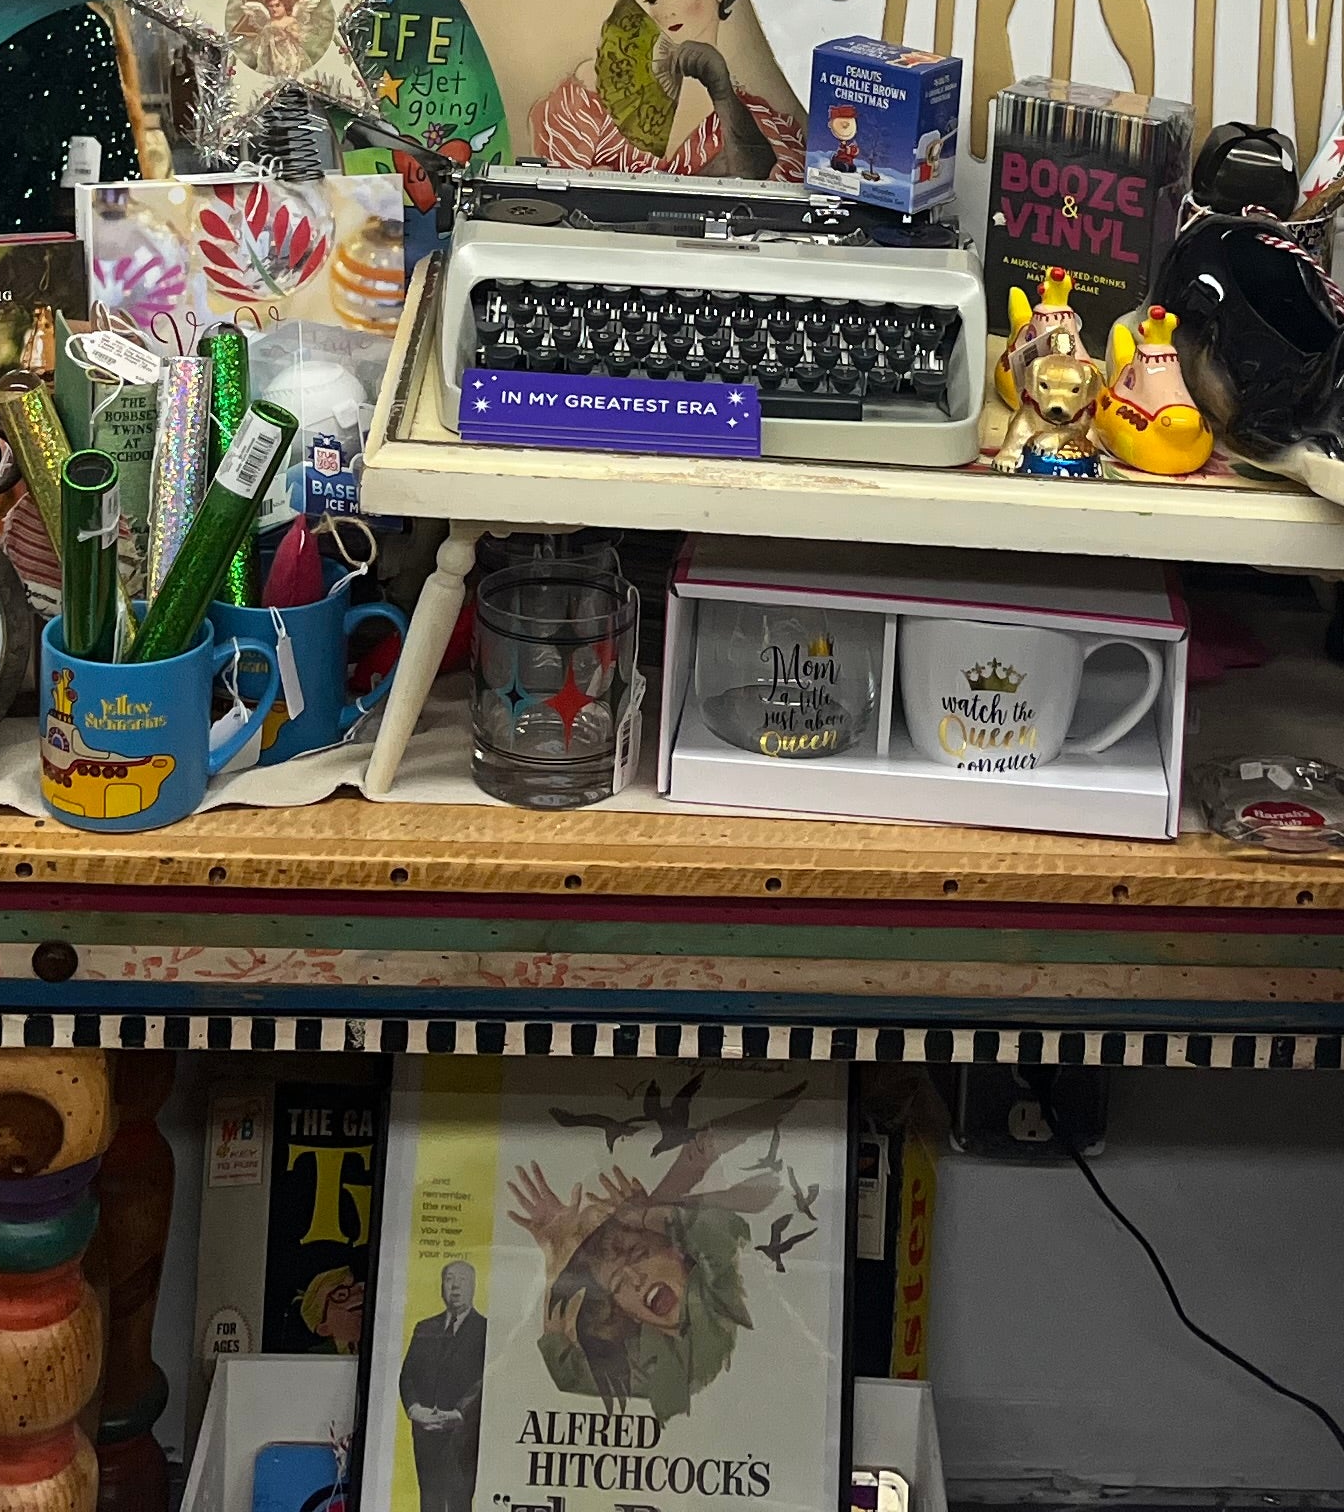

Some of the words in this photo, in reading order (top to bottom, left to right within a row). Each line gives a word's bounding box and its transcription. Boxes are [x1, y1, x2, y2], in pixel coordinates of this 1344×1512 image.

[370, 11, 467, 66] IFE!
[846, 65, 883, 82] PEANUTS
[829, 74, 871, 95] CHARLIE
[873, 84, 907, 101] BROWN
[834, 88, 890, 110] CHRISTMAS
[408, 96, 489, 127] going!
[1001, 151, 1147, 218] BOOZE
[1061, 195, 1079, 219] &
[1001, 196, 1140, 264] VINYL
[1074, 284, 1100, 296] GAME
[120, 397, 147, 408] THE
[499, 390, 524, 409] IN
[529, 391, 561, 411] MY
[564, 393, 672, 415] GREATEST
[676, 398, 718, 418] ERA
[112, 423, 154, 435] TWINS
[105, 450, 154, 462] SCHOO
[123, 439, 141, 450] AT
[325, 499, 345, 512] ICE
[760, 643, 841, 700] Mom
[942, 694, 1010, 726] watch
[1013, 701, 1036, 721] the
[760, 729, 838, 759] Queen
[939, 714, 1038, 760] Queen
[287, 1109, 333, 1136] THE
[217, 1322, 237, 1335] FOR
[213, 1339, 240, 1353] AGES
[516, 1410, 662, 1449] ALFRED
[526, 1451, 771, 1498] HITCHCOCK'S
